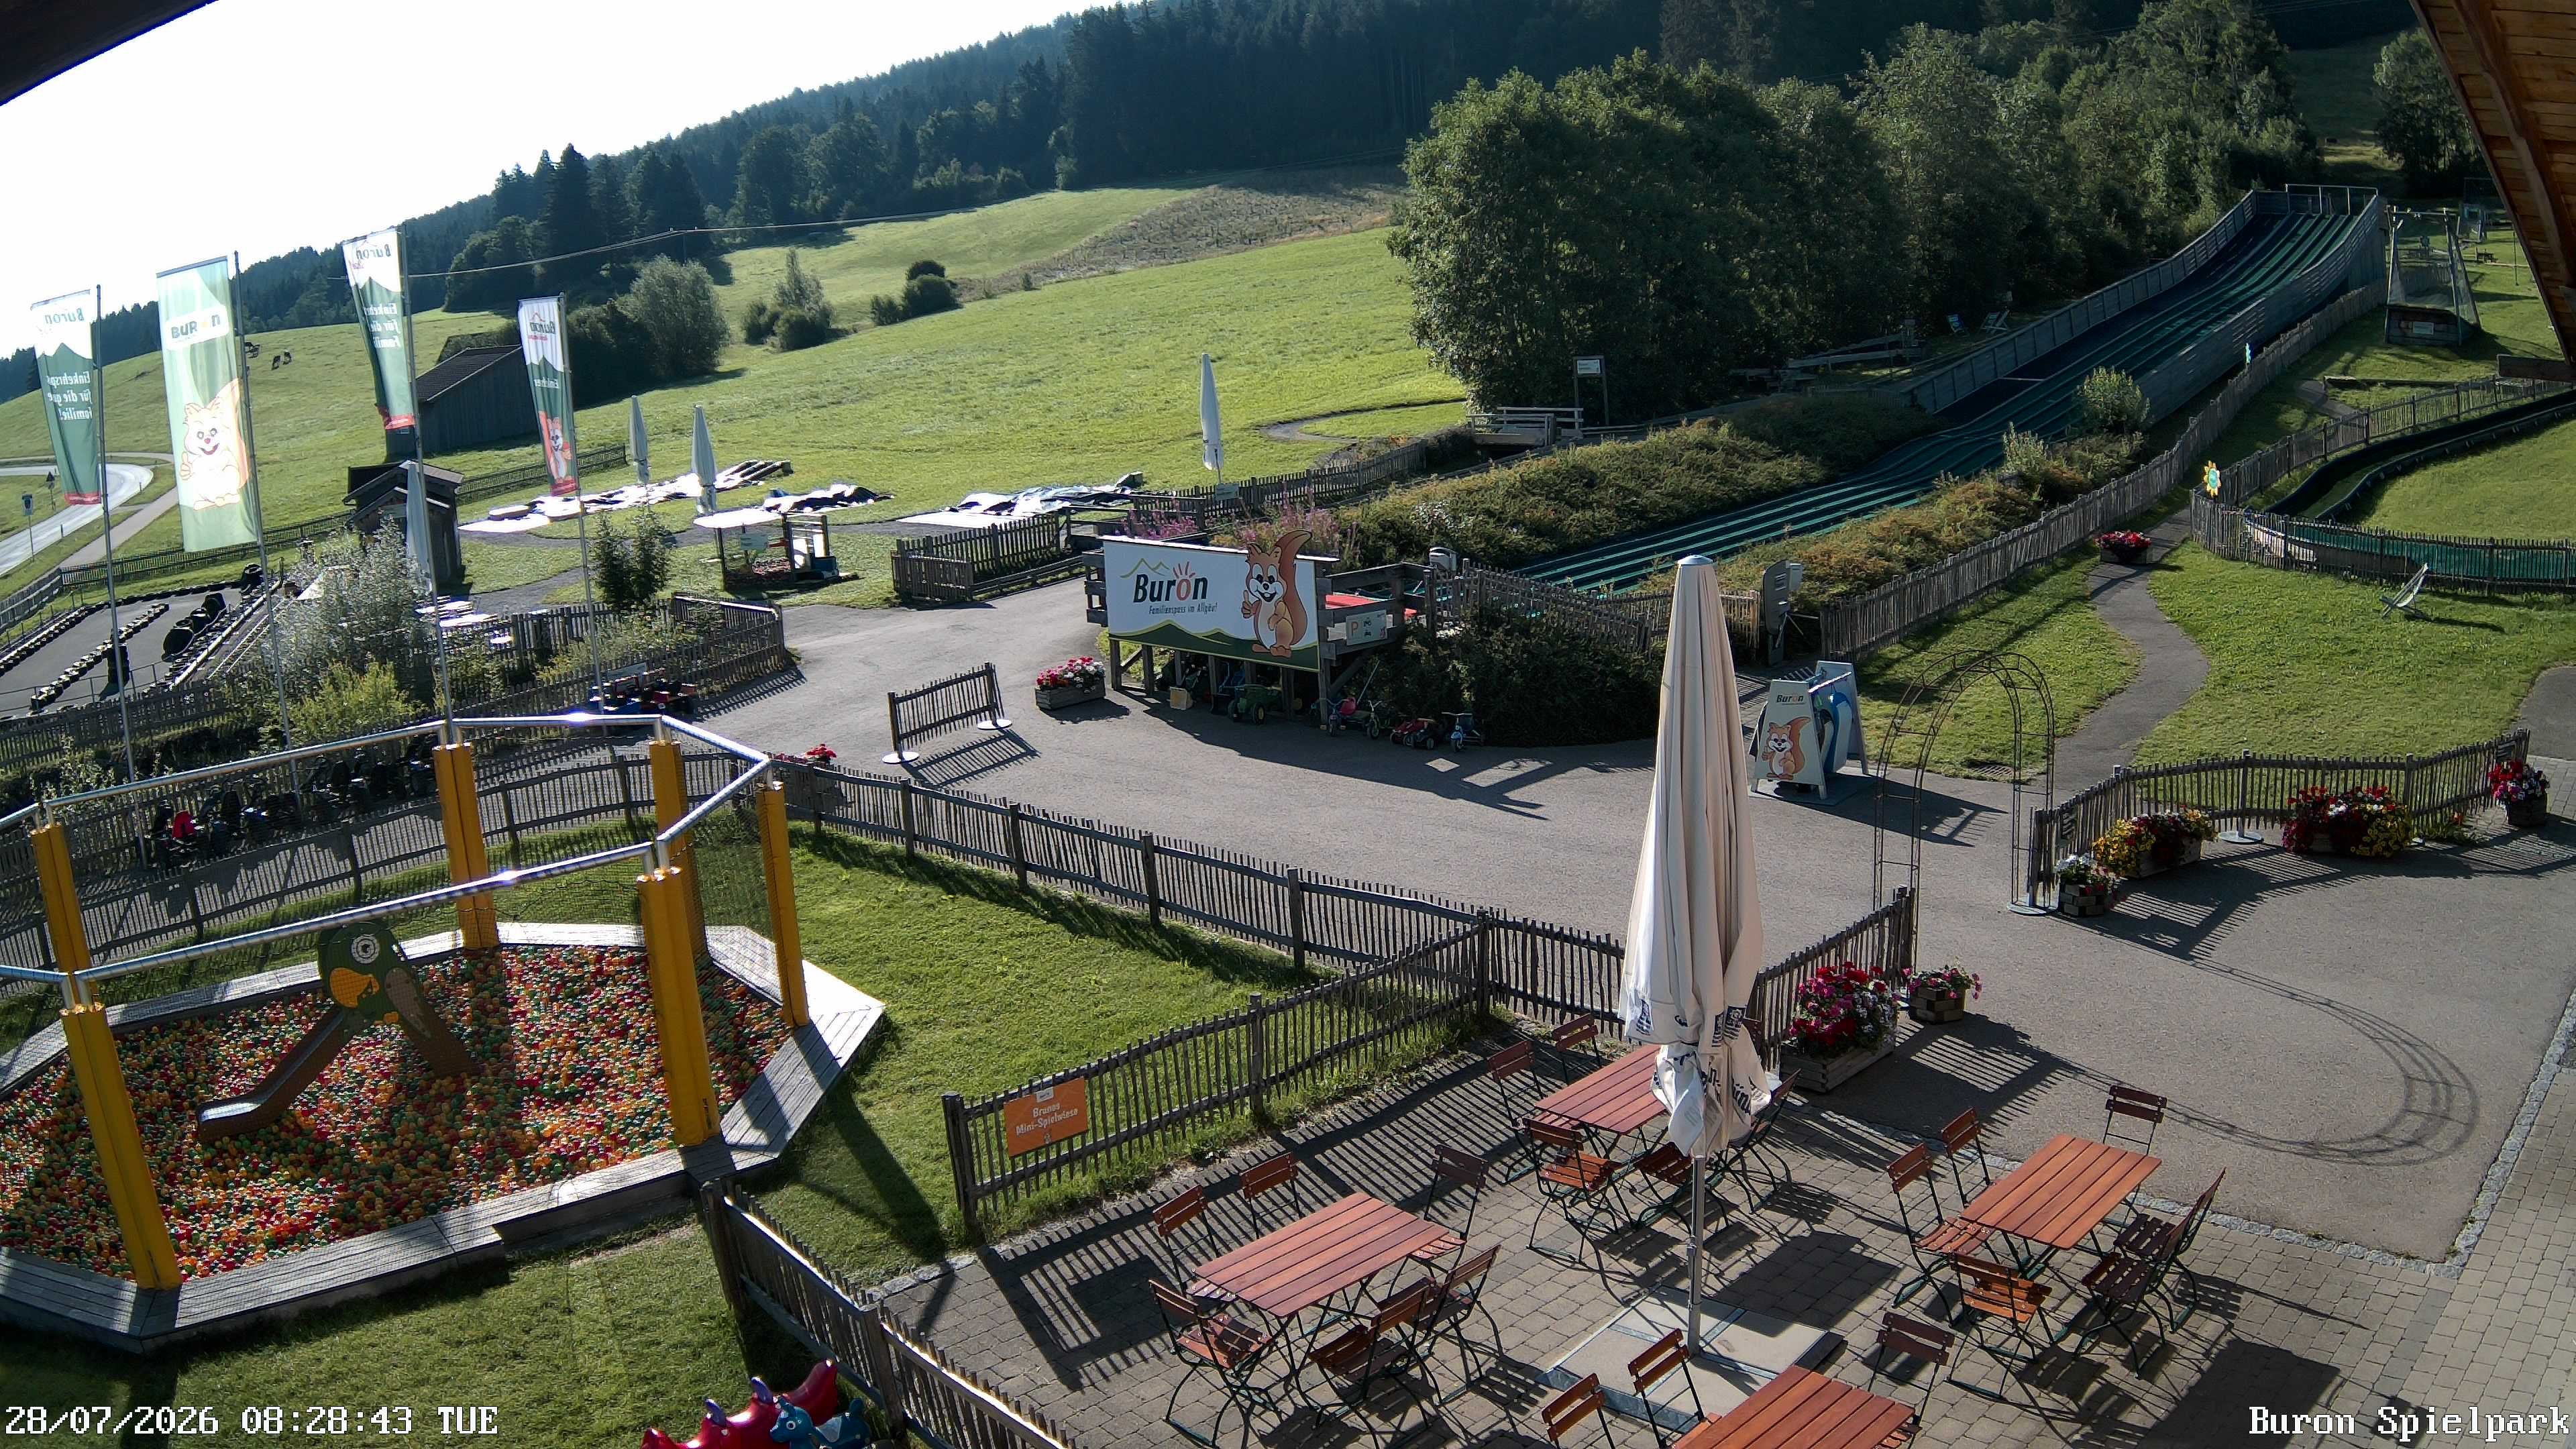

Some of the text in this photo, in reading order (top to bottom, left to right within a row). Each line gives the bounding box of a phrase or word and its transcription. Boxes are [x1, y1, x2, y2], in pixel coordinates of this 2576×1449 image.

[1133, 574, 1208, 603] Buron
[1351, 621, 1358, 637] P
[1776, 694, 1804, 703] Buron
